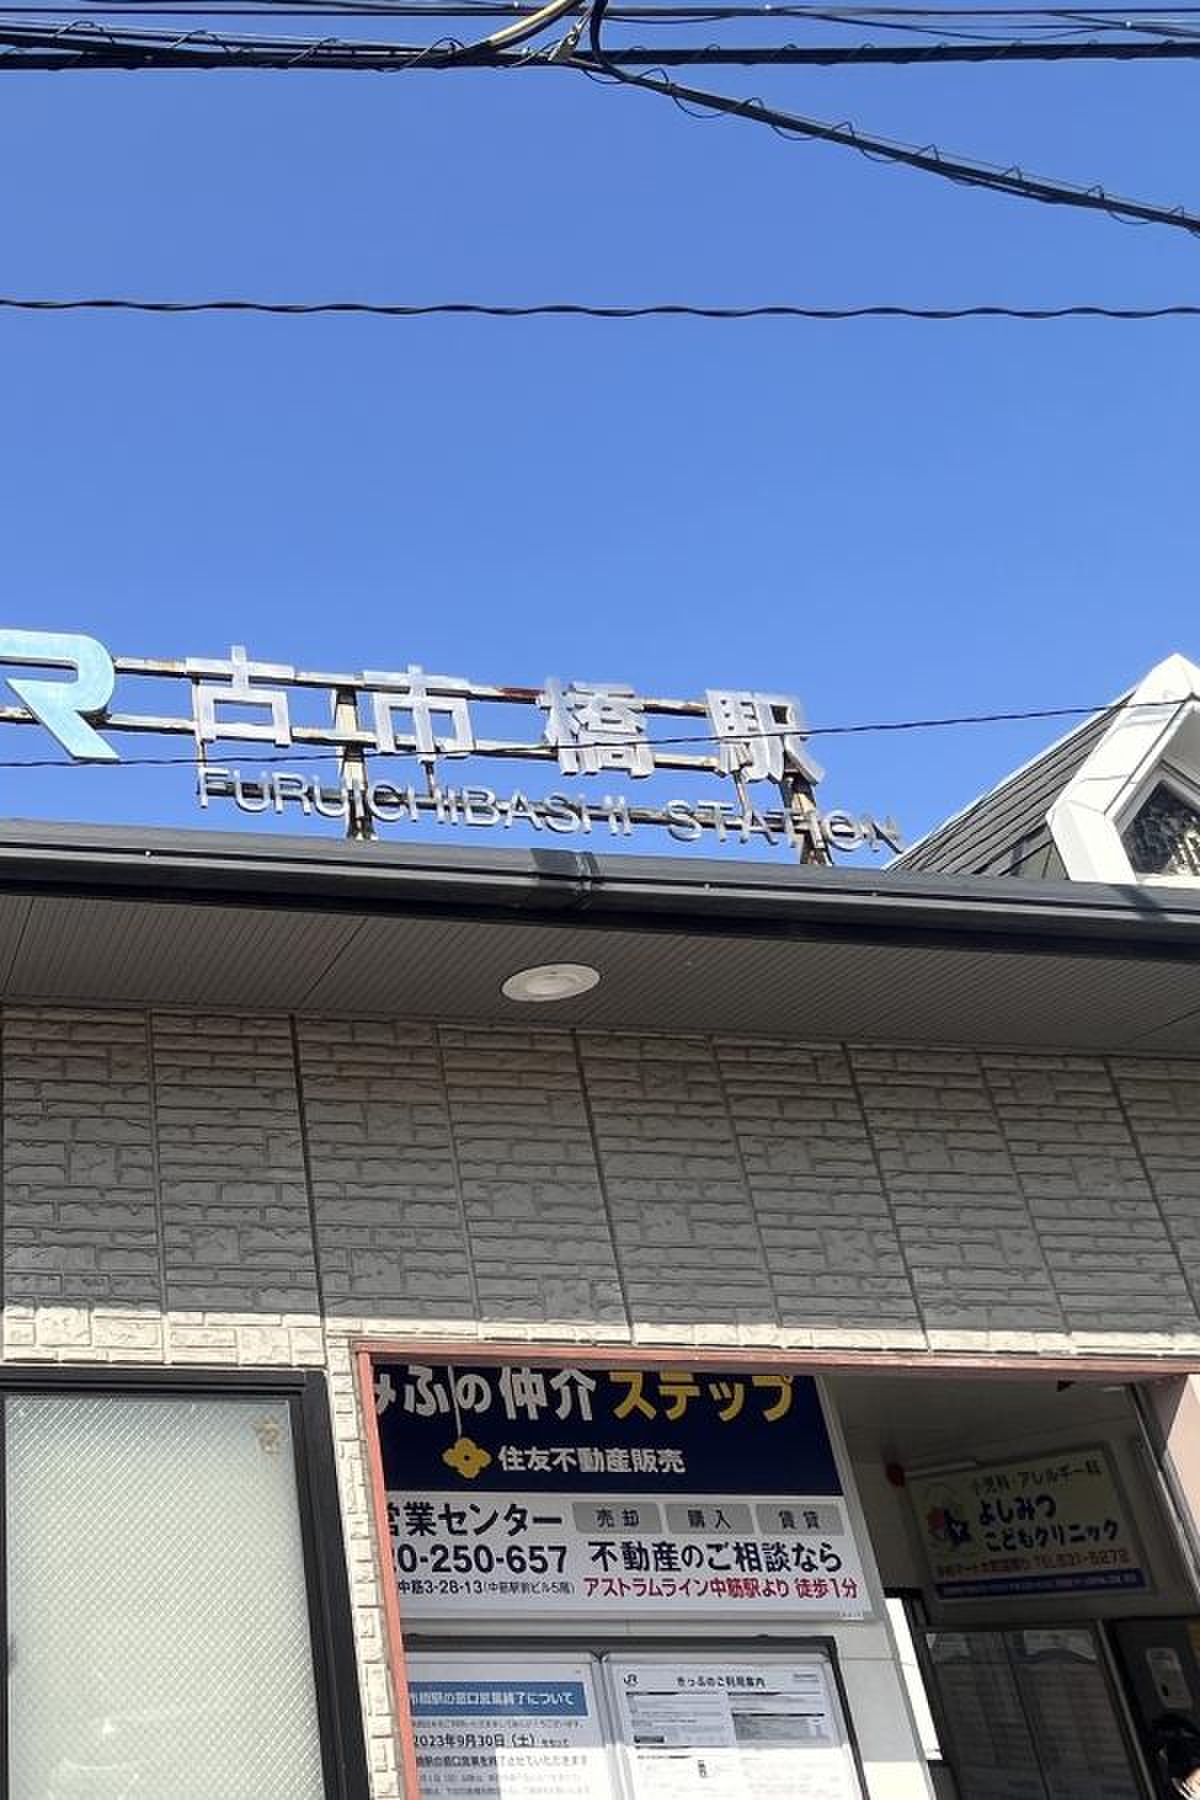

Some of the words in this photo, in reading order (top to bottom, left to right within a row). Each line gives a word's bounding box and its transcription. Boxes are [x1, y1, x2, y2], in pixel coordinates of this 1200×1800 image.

[184, 645, 826, 786] 古市橋駅
[197, 766, 633, 838] FURUICHIBASHI
[666, 799, 903, 856] STATION
[610, 1369, 794, 1422] ステップ
[499, 1446, 686, 1473] 住友不動産販売
[596, 1509, 639, 1528] 売却
[687, 1510, 731, 1530] 購入
[978, 1494, 1057, 1526] よしみつ
[985, 1519, 1119, 1552] こどもクリニック
[393, 1544, 567, 1574] 0-250-657
[588, 1541, 843, 1573] 不動産のご相談なら
